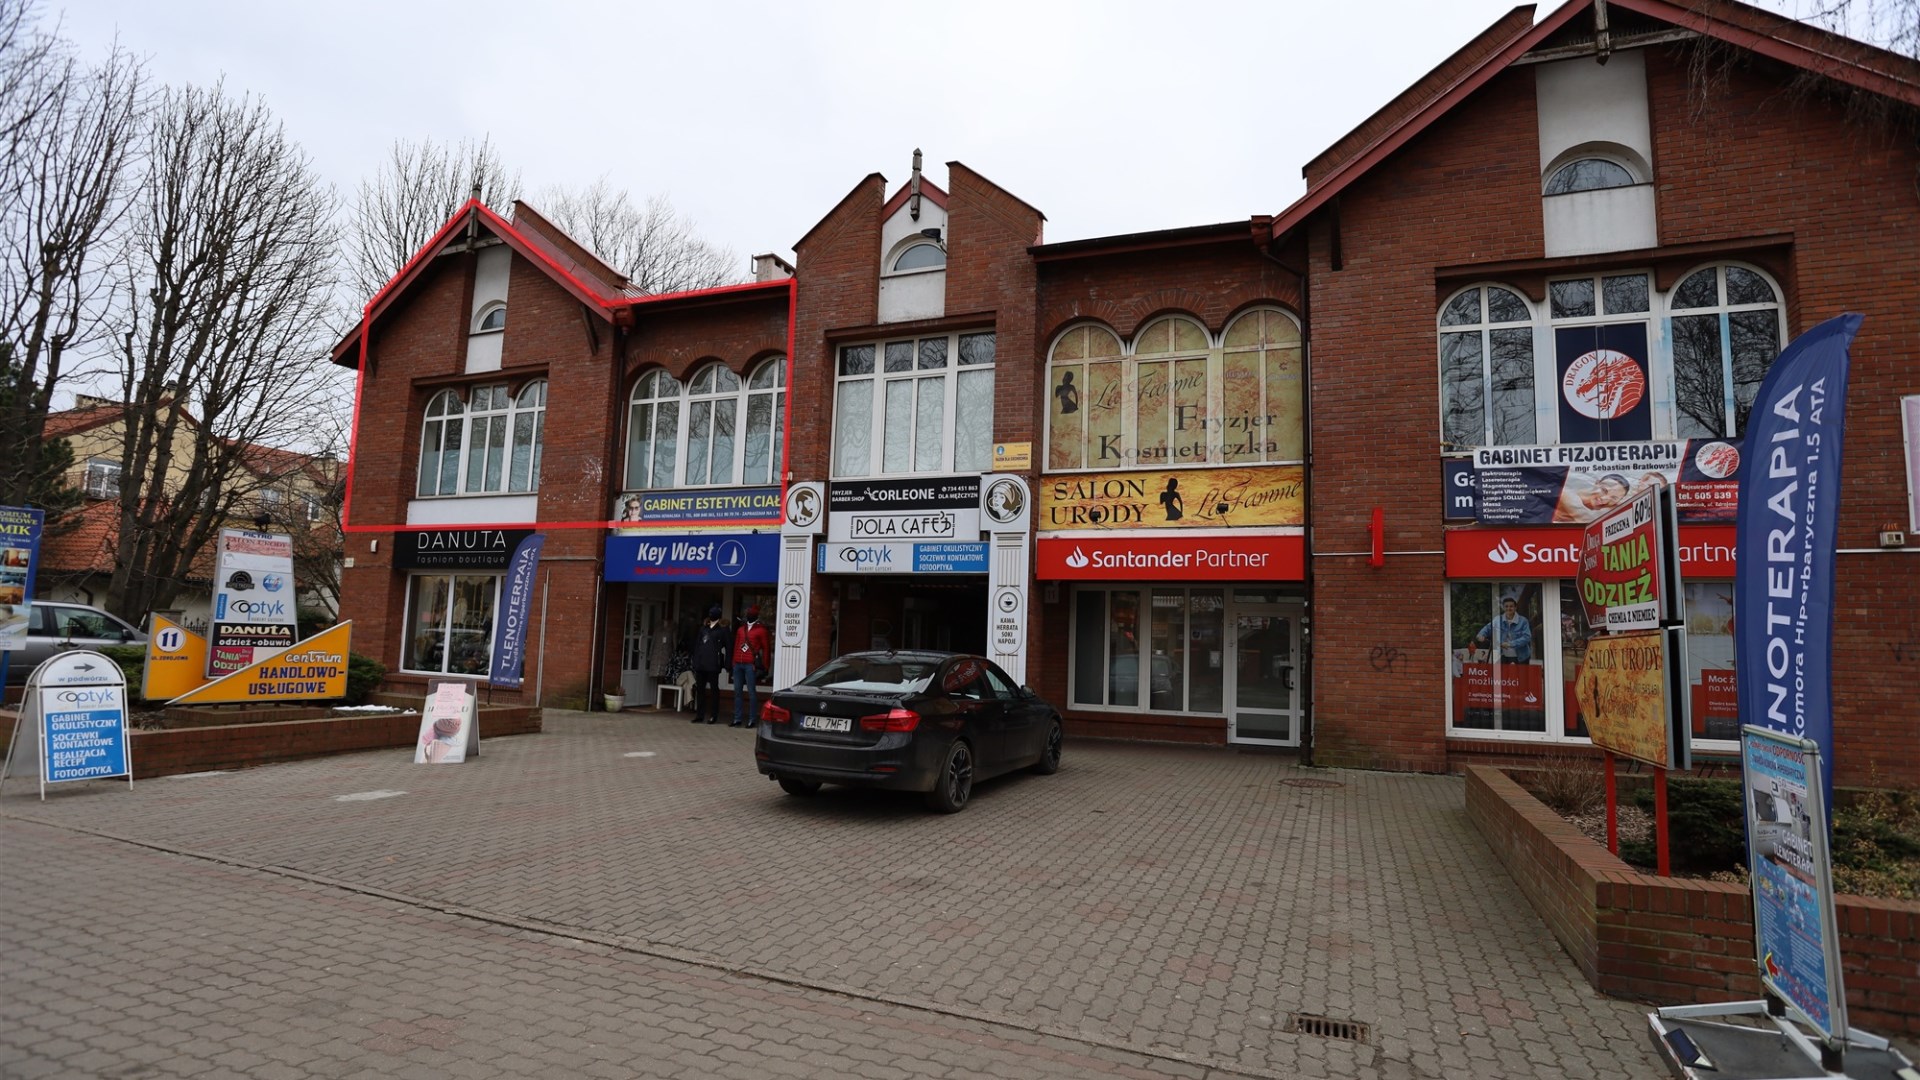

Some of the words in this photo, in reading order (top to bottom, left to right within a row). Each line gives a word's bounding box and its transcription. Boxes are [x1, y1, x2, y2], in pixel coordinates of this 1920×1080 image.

[1566, 352, 1596, 386] DRAGON
[1810, 376, 1826, 424] ATA
[1175, 404, 1278, 433] Fryzjer
[1098, 431, 1279, 460] Kosmetyczka
[1807, 432, 1820, 461] 1.5
[1480, 448, 1552, 464] GABINET
[1559, 444, 1677, 462] FIZJOTERAPII
[1632, 462, 1677, 470] Bratkowski
[872, 488, 935, 500] CORLEONE
[1054, 479, 1146, 500] SALON
[1678, 492, 1692, 500] tel.
[1694, 492, 1712, 500] 605
[644, 498, 693, 511] GABINET
[696, 496, 750, 510] ESTETYKI
[1634, 496, 1651, 525] 60%
[1050, 504, 1149, 525] URODY
[0, 524, 31, 536] MIK
[856, 519, 896, 534] POLA
[1605, 516, 1630, 538] PRZECENA
[418, 530, 506, 549] DANUTA
[459, 555, 505, 564] boutique
[637, 542, 668, 566] Key
[671, 542, 714, 561] West
[847, 545, 892, 571] optyk
[919, 554, 946, 562] SOCZEWKI
[1092, 549, 1192, 568] Santander
[1196, 549, 1270, 567] Partner
[1523, 544, 1580, 563] Sant
[1602, 533, 1650, 572] TANIA
[1766, 384, 1802, 733] NOTERAPIA
[1795, 464, 1818, 644] Hiperbaryczna
[1584, 568, 1653, 608] ODZIEŻ
[239, 600, 284, 621] optyk
[1608, 612, 1626, 624] CHEMIA
[1627, 611, 1632, 622] Z
[1632, 608, 1656, 622] NIEMIEC
[162, 632, 178, 648] 11
[216, 649, 240, 660] TANIA
[285, 651, 342, 663] centrum
[1590, 648, 1617, 670] SALON
[1622, 646, 1660, 670] URODY
[260, 666, 344, 679] HANDLOWO-
[1468, 668, 1488, 676] Moc
[1708, 675, 1728, 683] Moc
[249, 682, 326, 695] USŁUGOWE
[1468, 678, 1519, 686] możliwości
[66, 688, 114, 708] optyk
[1793, 654, 1804, 738] Komora
[52, 713, 90, 723] GABINET
[52, 719, 117, 730] OKULISTYCZNY
[805, 717, 821, 728] CAL
[825, 717, 848, 729] 7MF1
[52, 731, 98, 741] SOCZEWKI
[53, 738, 114, 750] KONTAKTOWE
[54, 749, 106, 760] REALIZACJA
[54, 758, 86, 768] RECEPT
[54, 766, 112, 778] FOTOOPTYKA
[1782, 829, 1813, 857] GABINET
